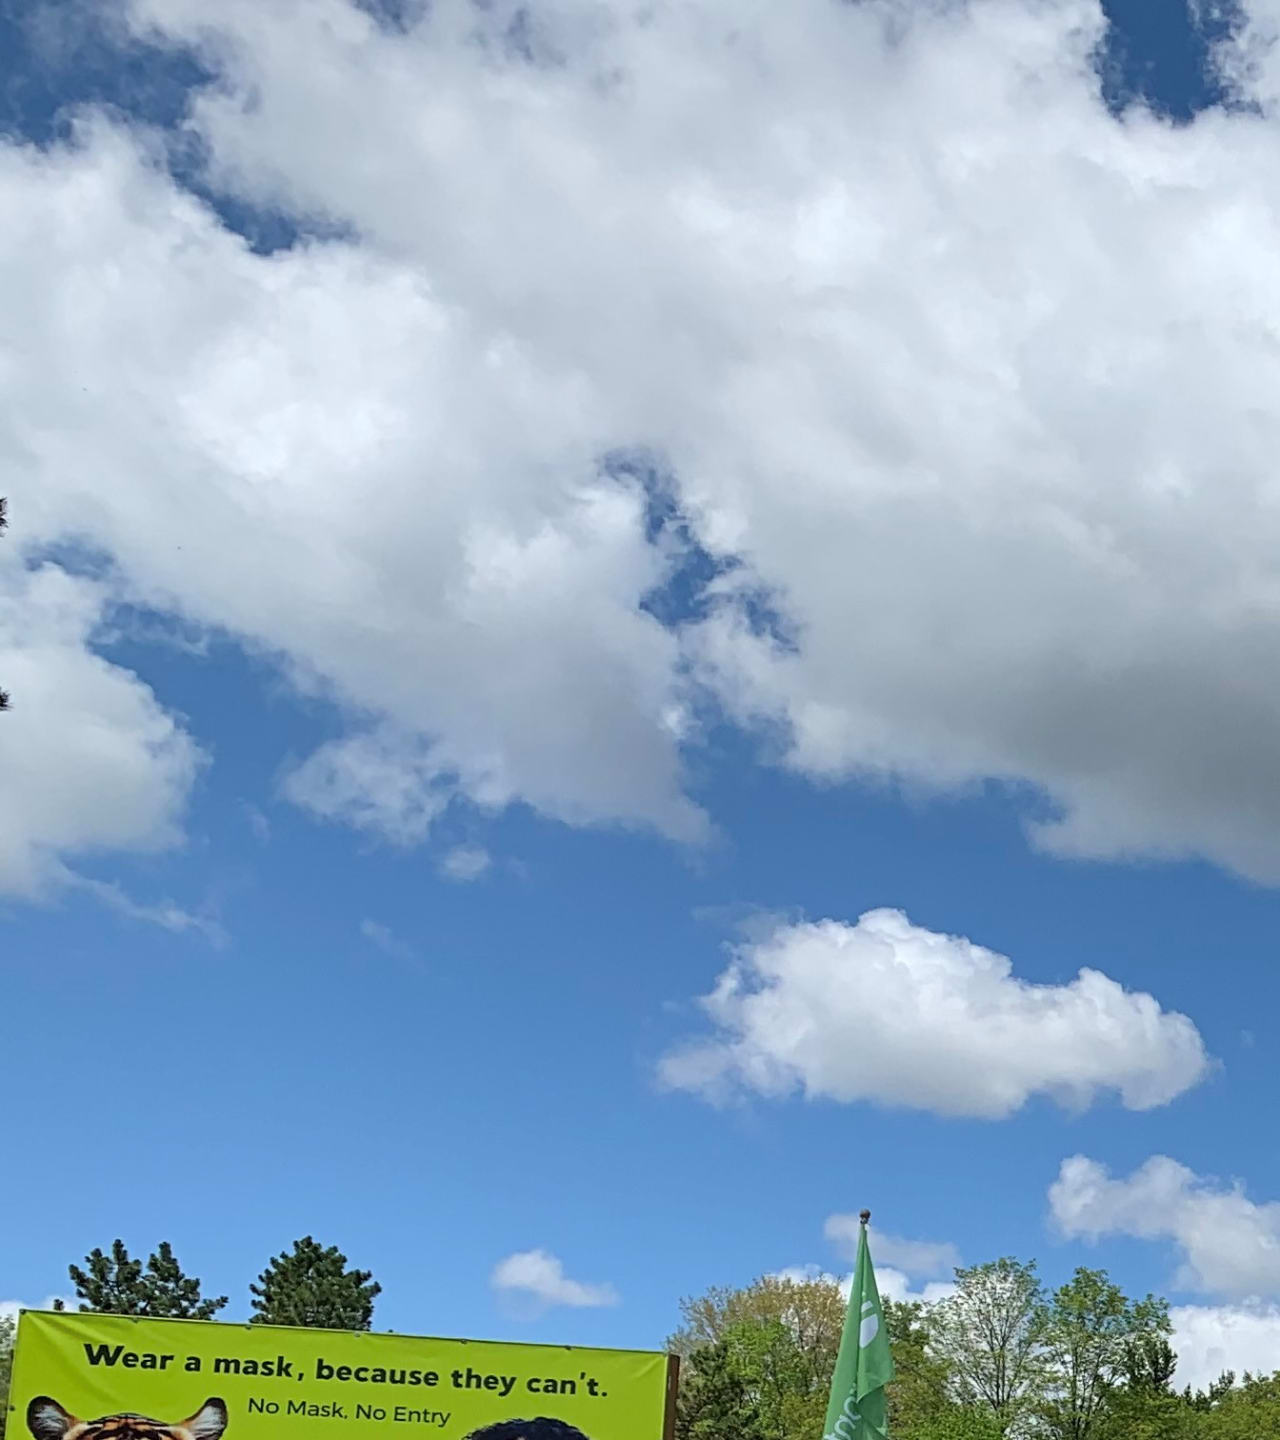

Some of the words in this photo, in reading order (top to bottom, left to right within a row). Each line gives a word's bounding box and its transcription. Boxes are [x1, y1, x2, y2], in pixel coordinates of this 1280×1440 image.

[84, 1343, 174, 1370] Wear
[184, 1356, 201, 1372] a
[213, 1356, 304, 1382] mask,
[316, 1358, 439, 1387] because
[451, 1368, 517, 1397] they
[526, 1372, 608, 1397] can't.
[248, 1398, 279, 1415] No
[356, 1404, 386, 1421] No
[394, 1406, 451, 1428] Entry
